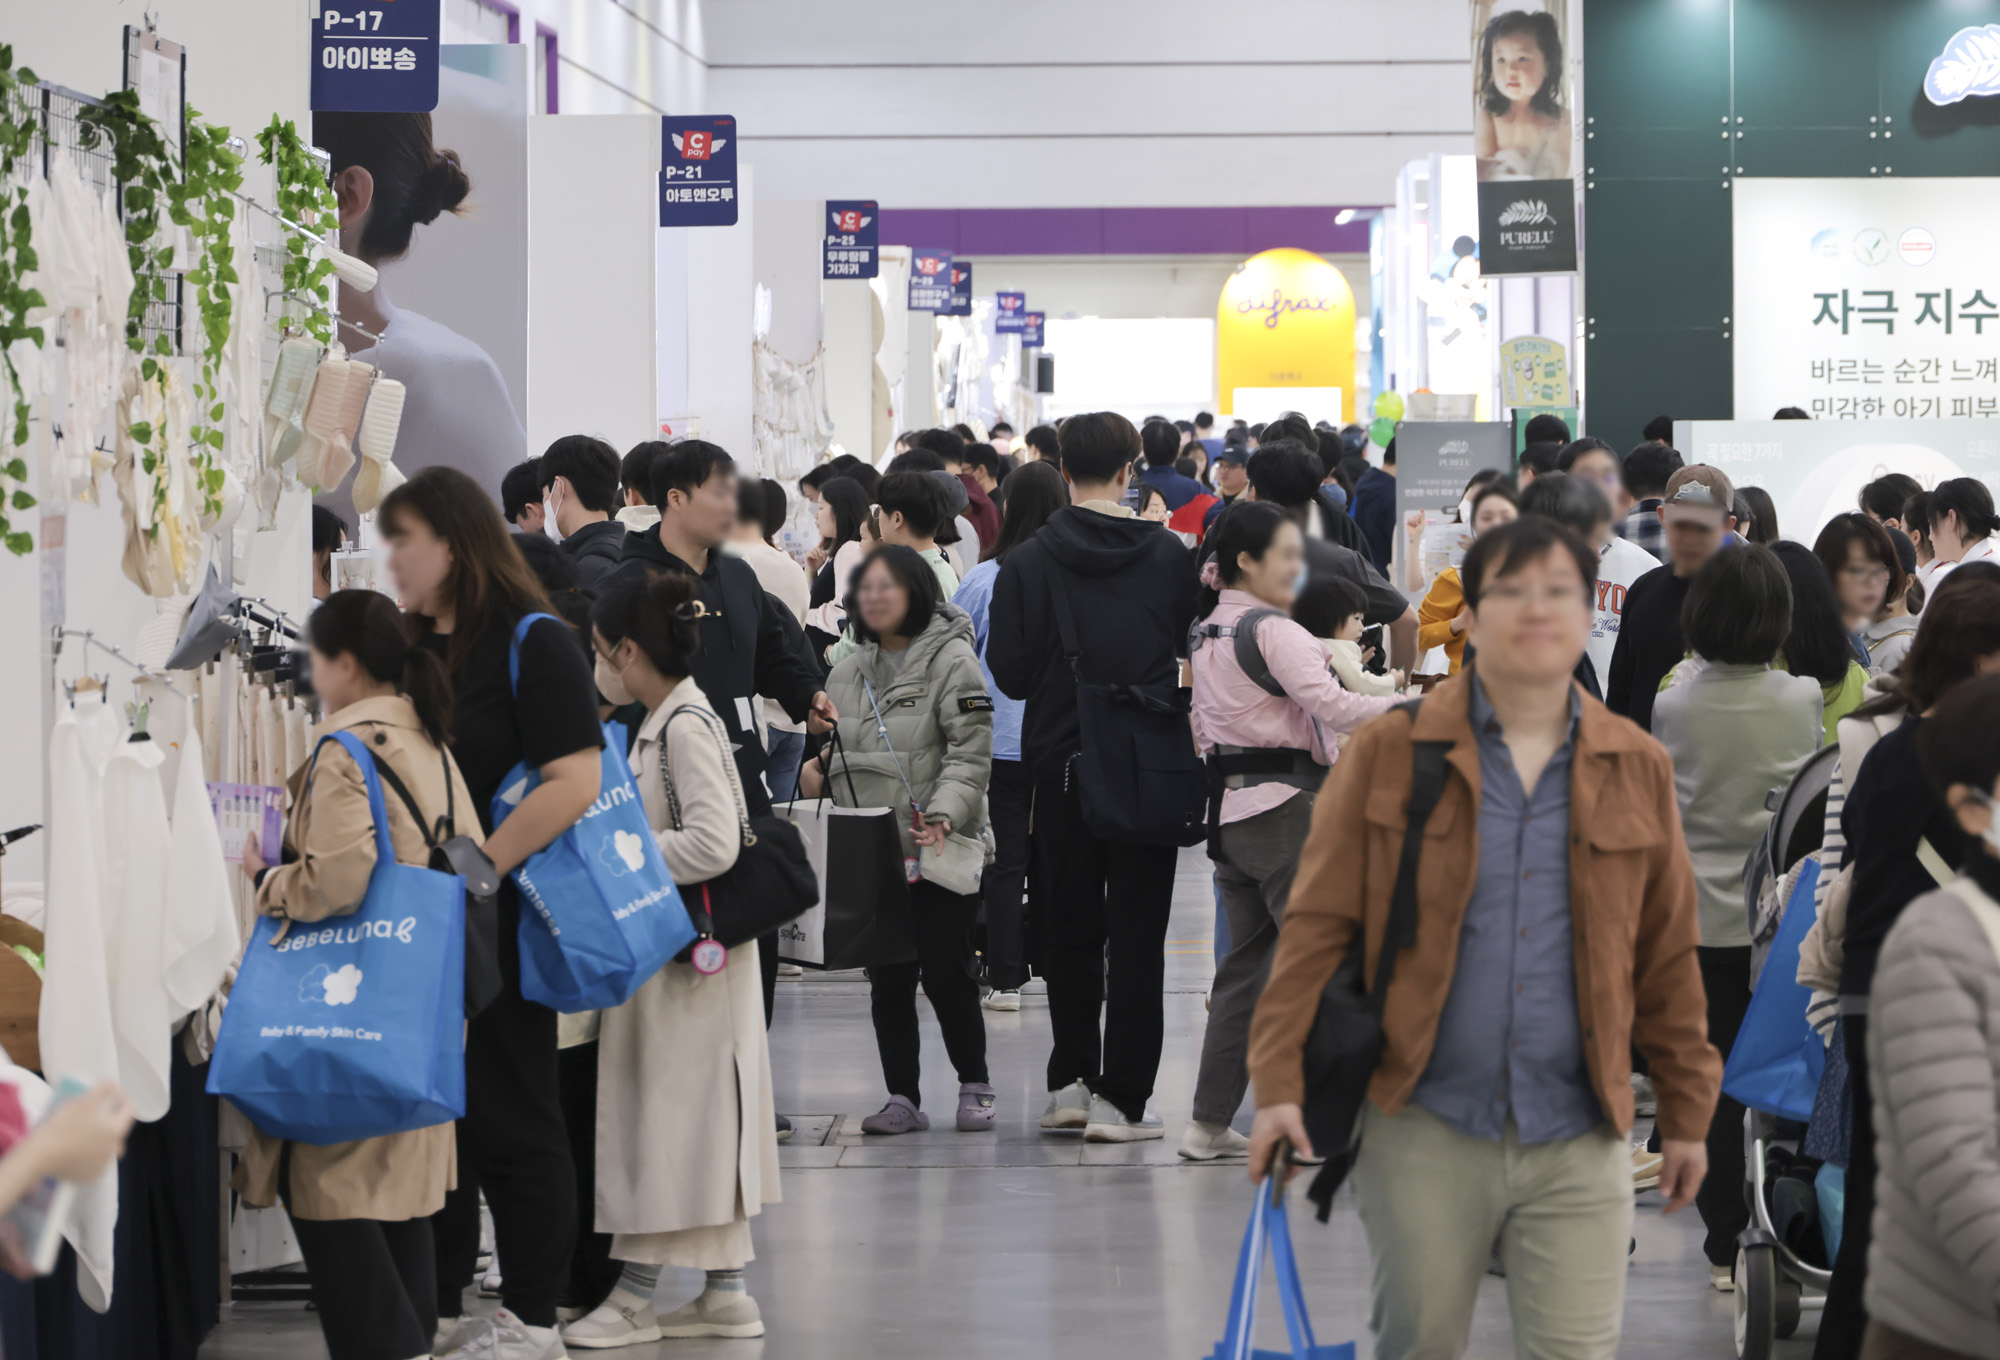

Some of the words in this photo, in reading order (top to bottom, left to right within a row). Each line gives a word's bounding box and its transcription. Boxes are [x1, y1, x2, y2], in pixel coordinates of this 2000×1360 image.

[324, 10, 383, 31] P-17
[322, 46, 417, 71] 아이뽀송
[687, 148, 704, 157] pay
[666, 165, 702, 179] P-21
[666, 187, 734, 203] 아토앤오투
[827, 235, 856, 246] P-25
[1500, 230, 1555, 245] PURELU
[1812, 288, 1899, 335] 자극
[1914, 288, 2000, 335] 지수
[1811, 357, 1885, 384] 바르는
[1893, 357, 1942, 384] 순간
[1950, 357, 1998, 384] 느껴
[1811, 396, 1886, 420] 민감한
[1893, 396, 1940, 420] 아기
[1950, 396, 1999, 420] 피부
[1595, 579, 1627, 615] YO
[260, 1026, 285, 1038] Baby
[285, 1025, 294, 1036] &
[295, 1025, 330, 1039] Family
[330, 1026, 354, 1038] Skin
[355, 1027, 382, 1041] Care
